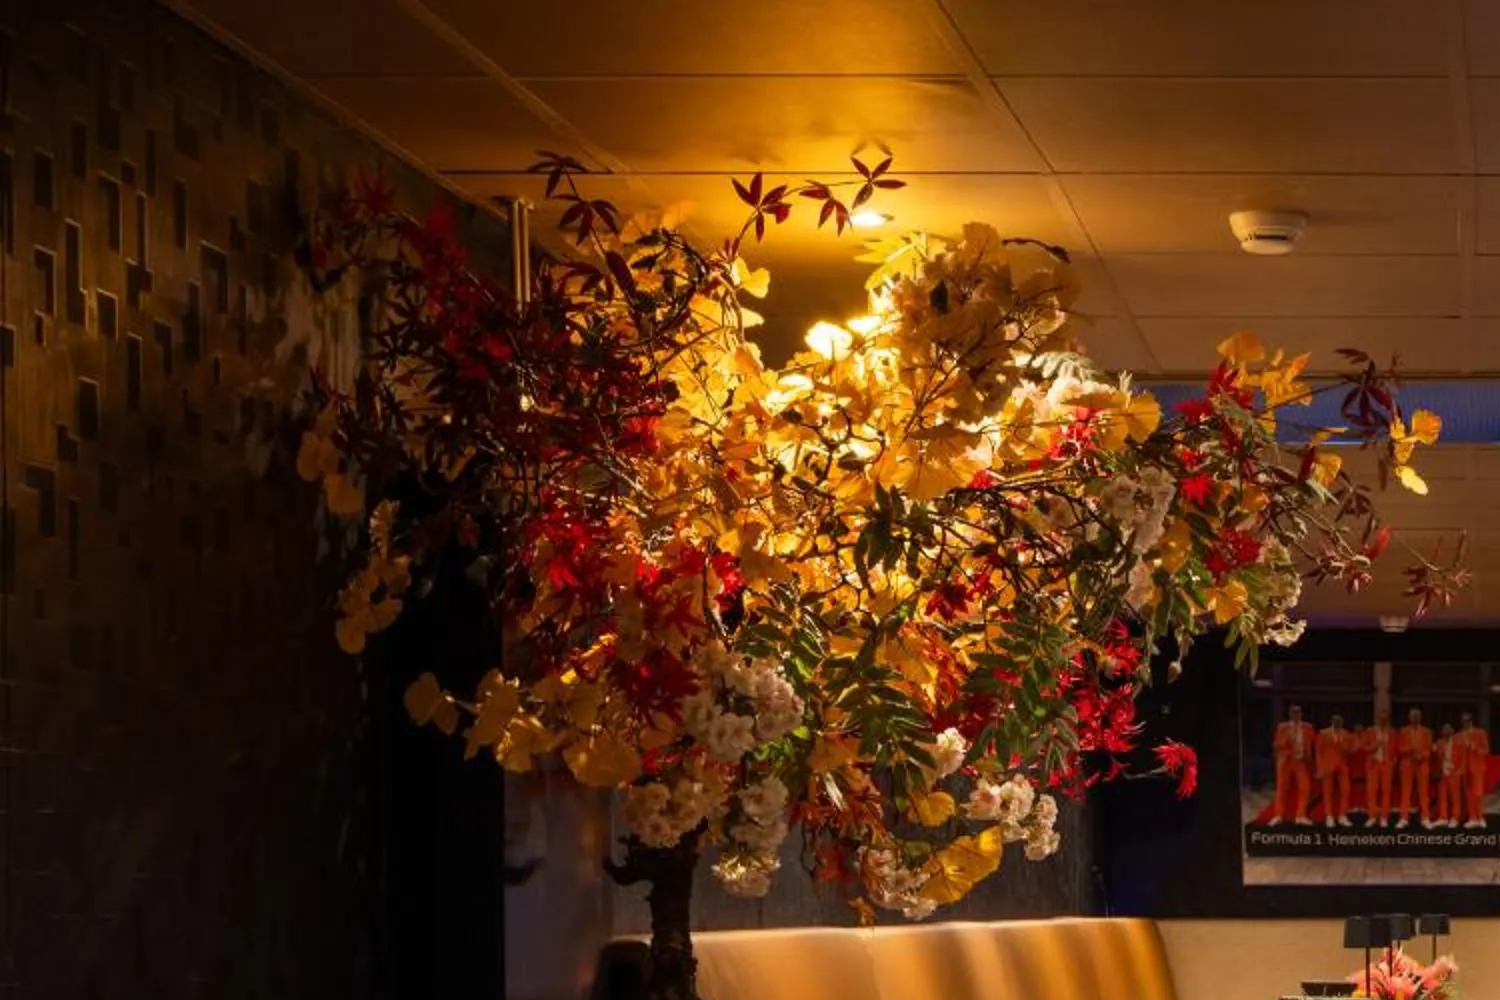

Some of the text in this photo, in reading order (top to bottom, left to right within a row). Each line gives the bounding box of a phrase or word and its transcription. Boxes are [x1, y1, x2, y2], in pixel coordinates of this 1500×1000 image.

[1251, 831, 1312, 846] Formula
[1329, 833, 1396, 846] Heineken
[1397, 832, 1452, 846] Chinese
[1455, 832, 1497, 846] Grand
